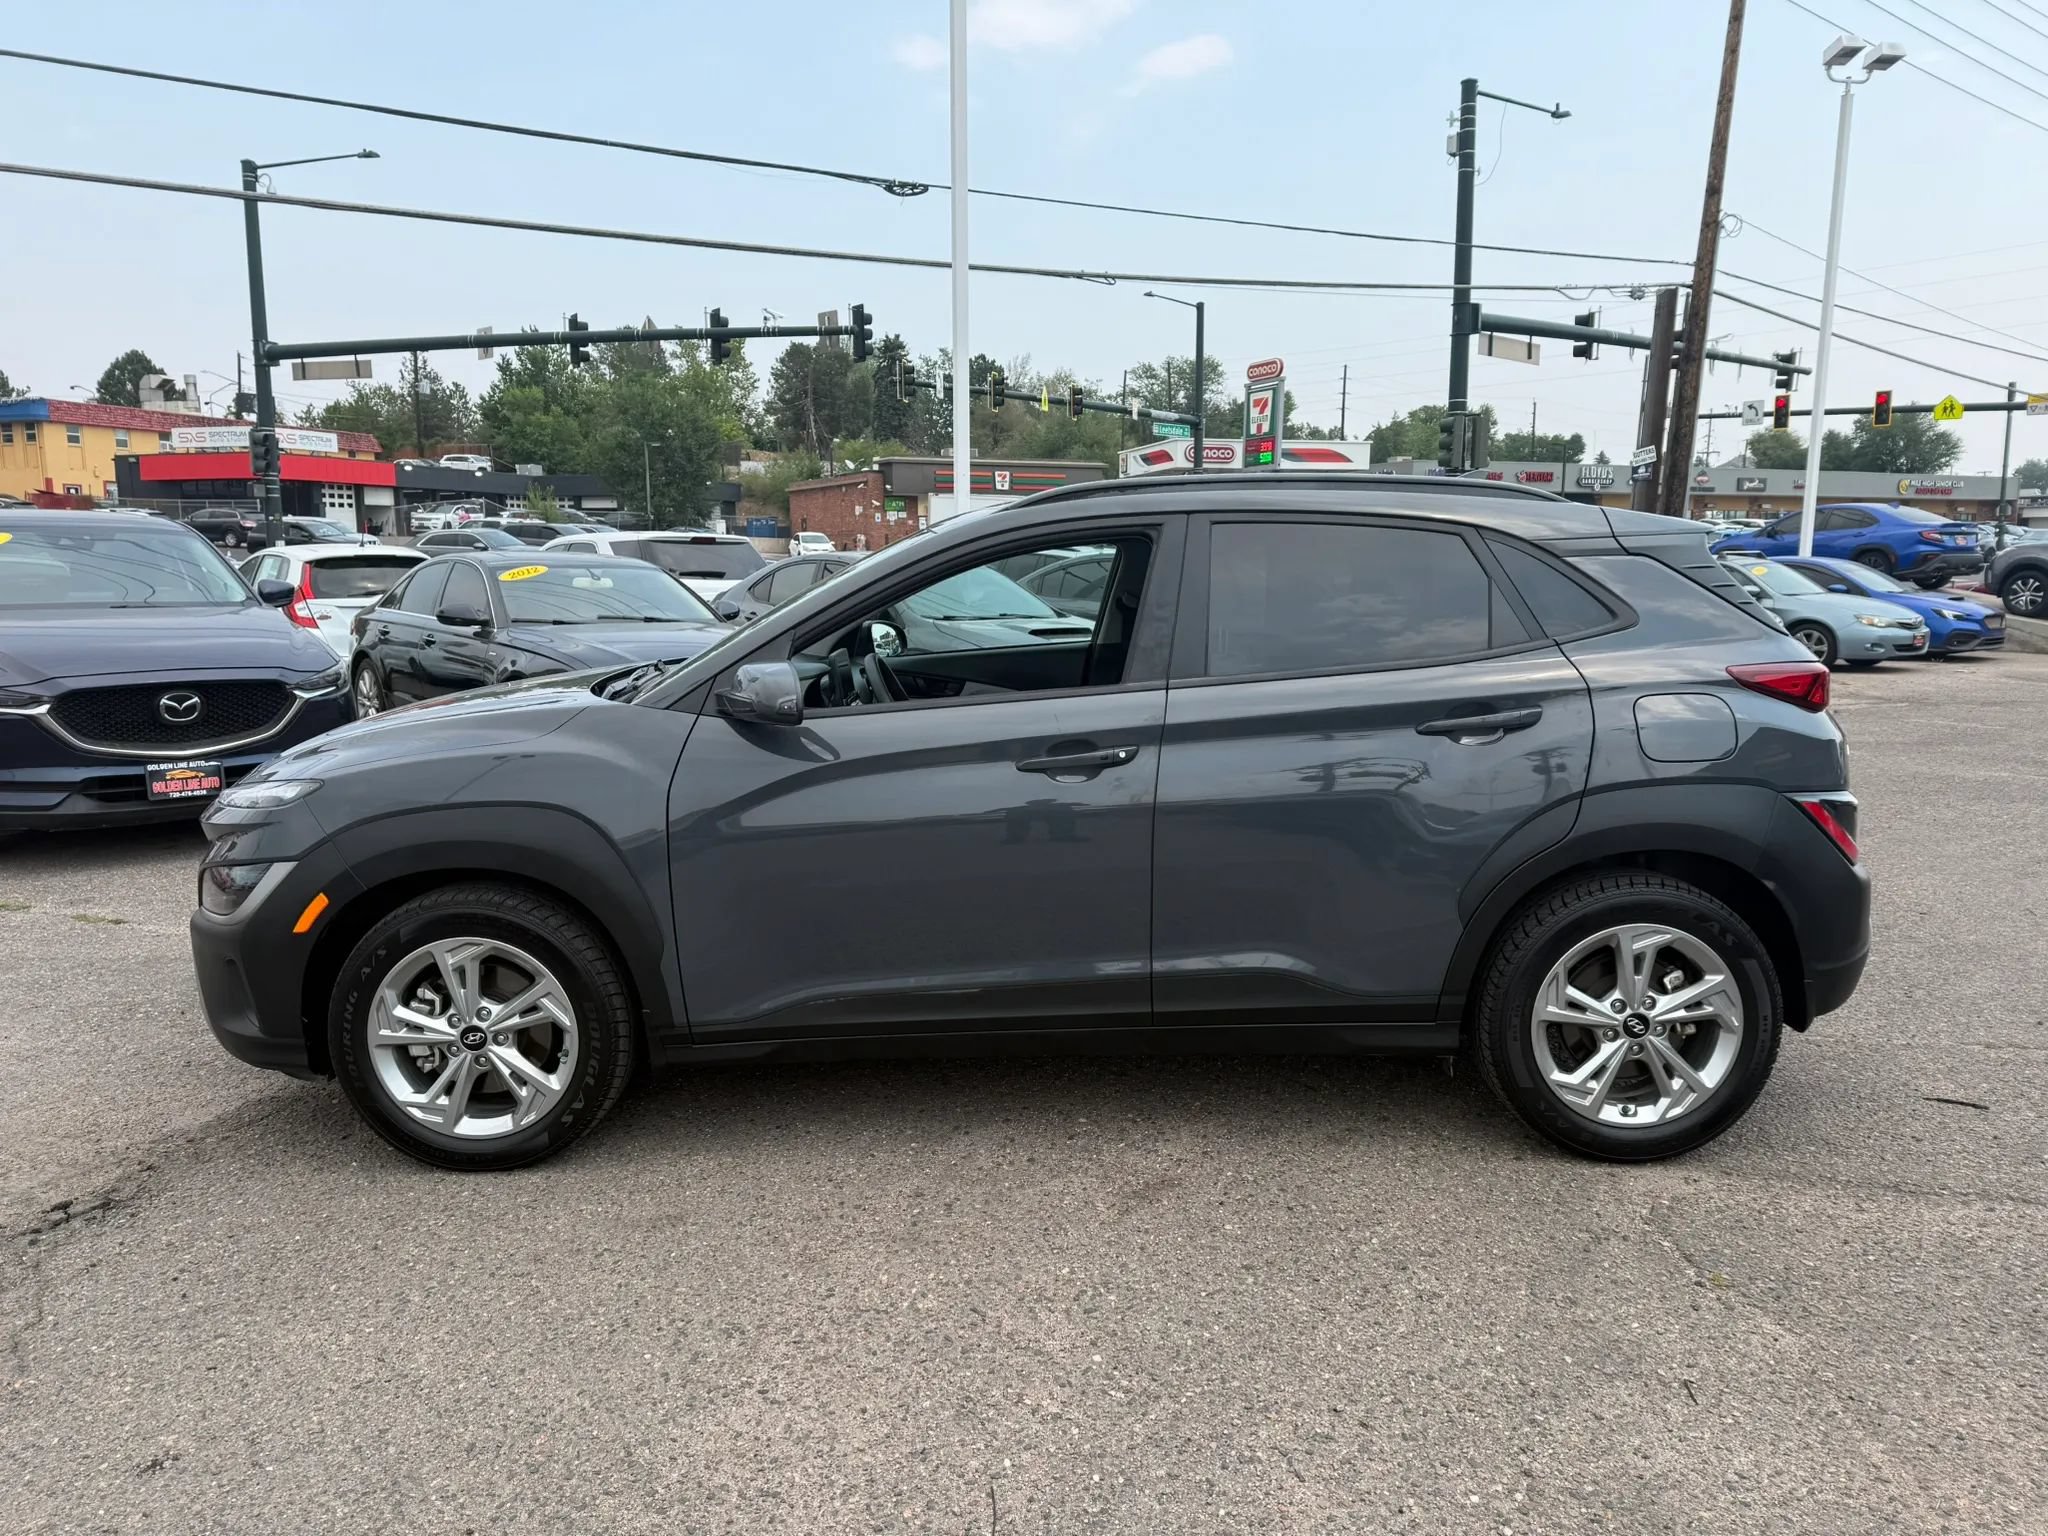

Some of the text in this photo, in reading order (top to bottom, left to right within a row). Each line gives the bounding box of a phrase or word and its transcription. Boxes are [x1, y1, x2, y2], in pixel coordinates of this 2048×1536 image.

[1252, 396, 1270, 425] 7
[208, 431, 247, 439] SPECTRUM
[1159, 425, 1184, 436] Leetsdale
[299, 434, 332, 443] SPECTRUM
[1582, 466, 1614, 478] FLOYD'S
[1953, 480, 1964, 488] CLUB
[152, 776, 220, 793] GOLDEN LINE AUTO
